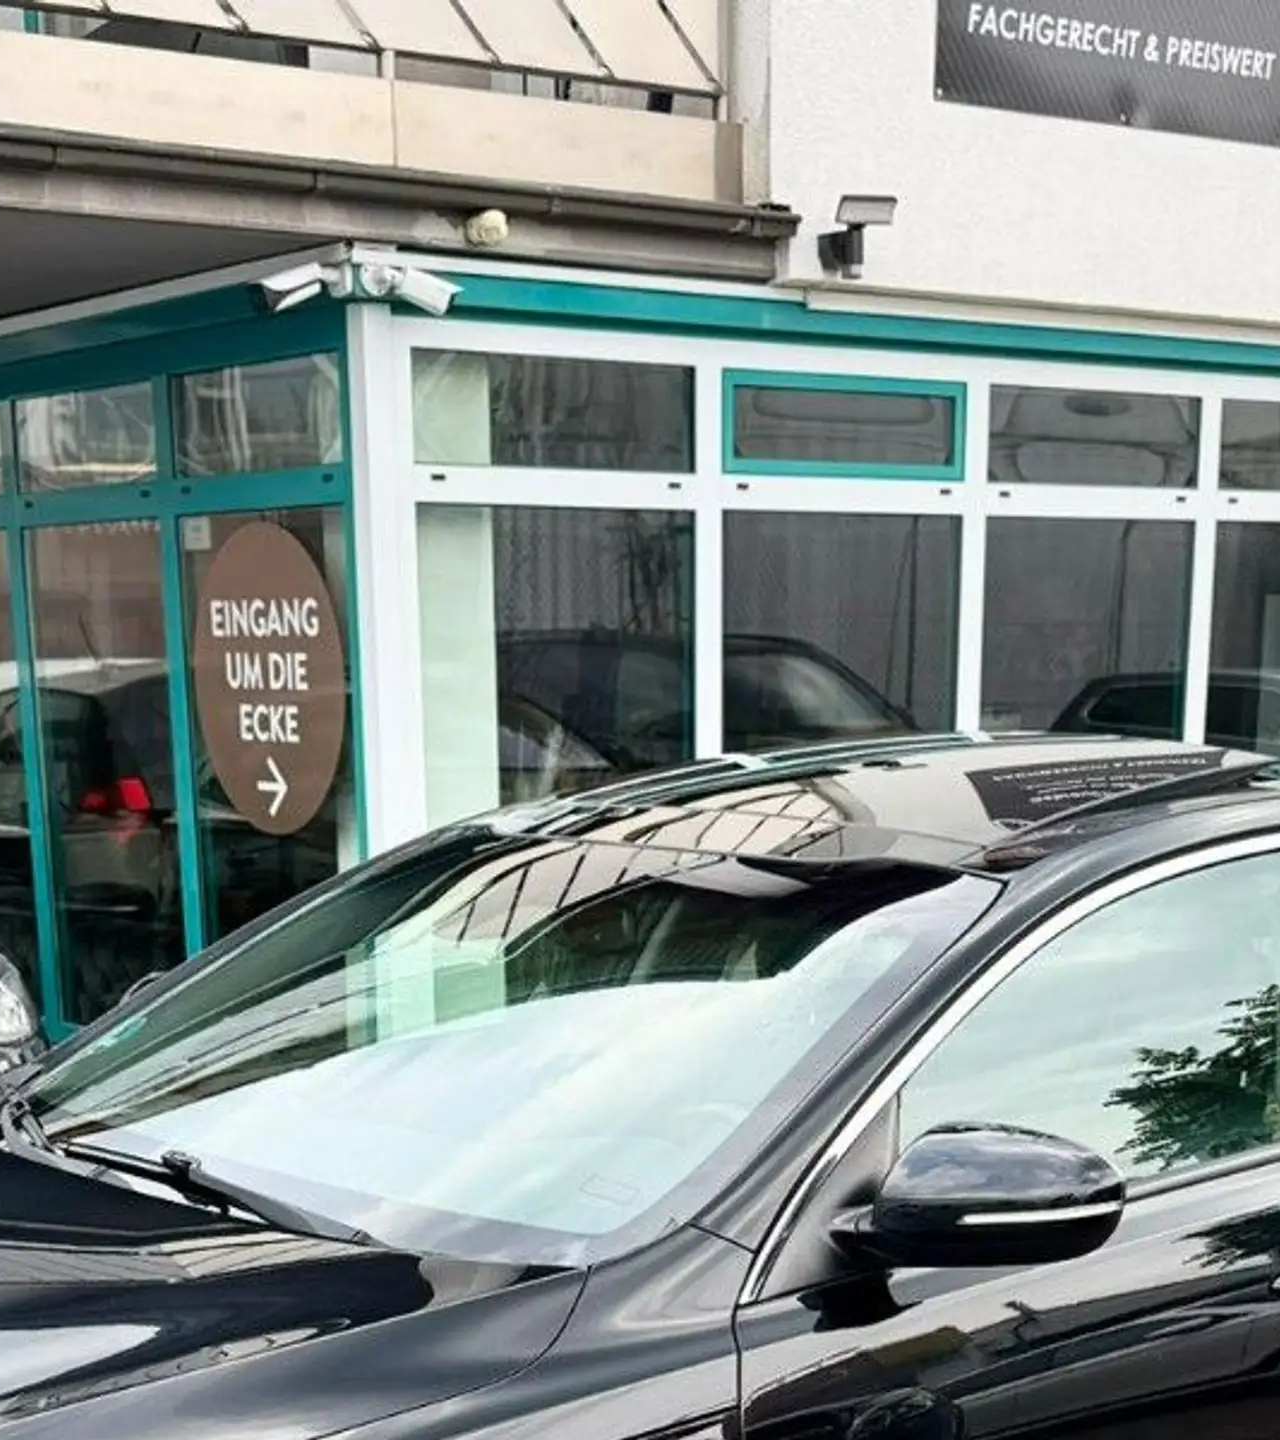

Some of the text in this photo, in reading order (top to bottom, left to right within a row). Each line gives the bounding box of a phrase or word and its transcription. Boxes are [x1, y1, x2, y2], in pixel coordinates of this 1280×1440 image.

[967, 3, 1277, 80] FACHGERECHT & PREISWERT
[209, 598, 320, 638] EINGANG
[225, 652, 309, 691] UM DIE
[238, 704, 301, 743] ECKE
